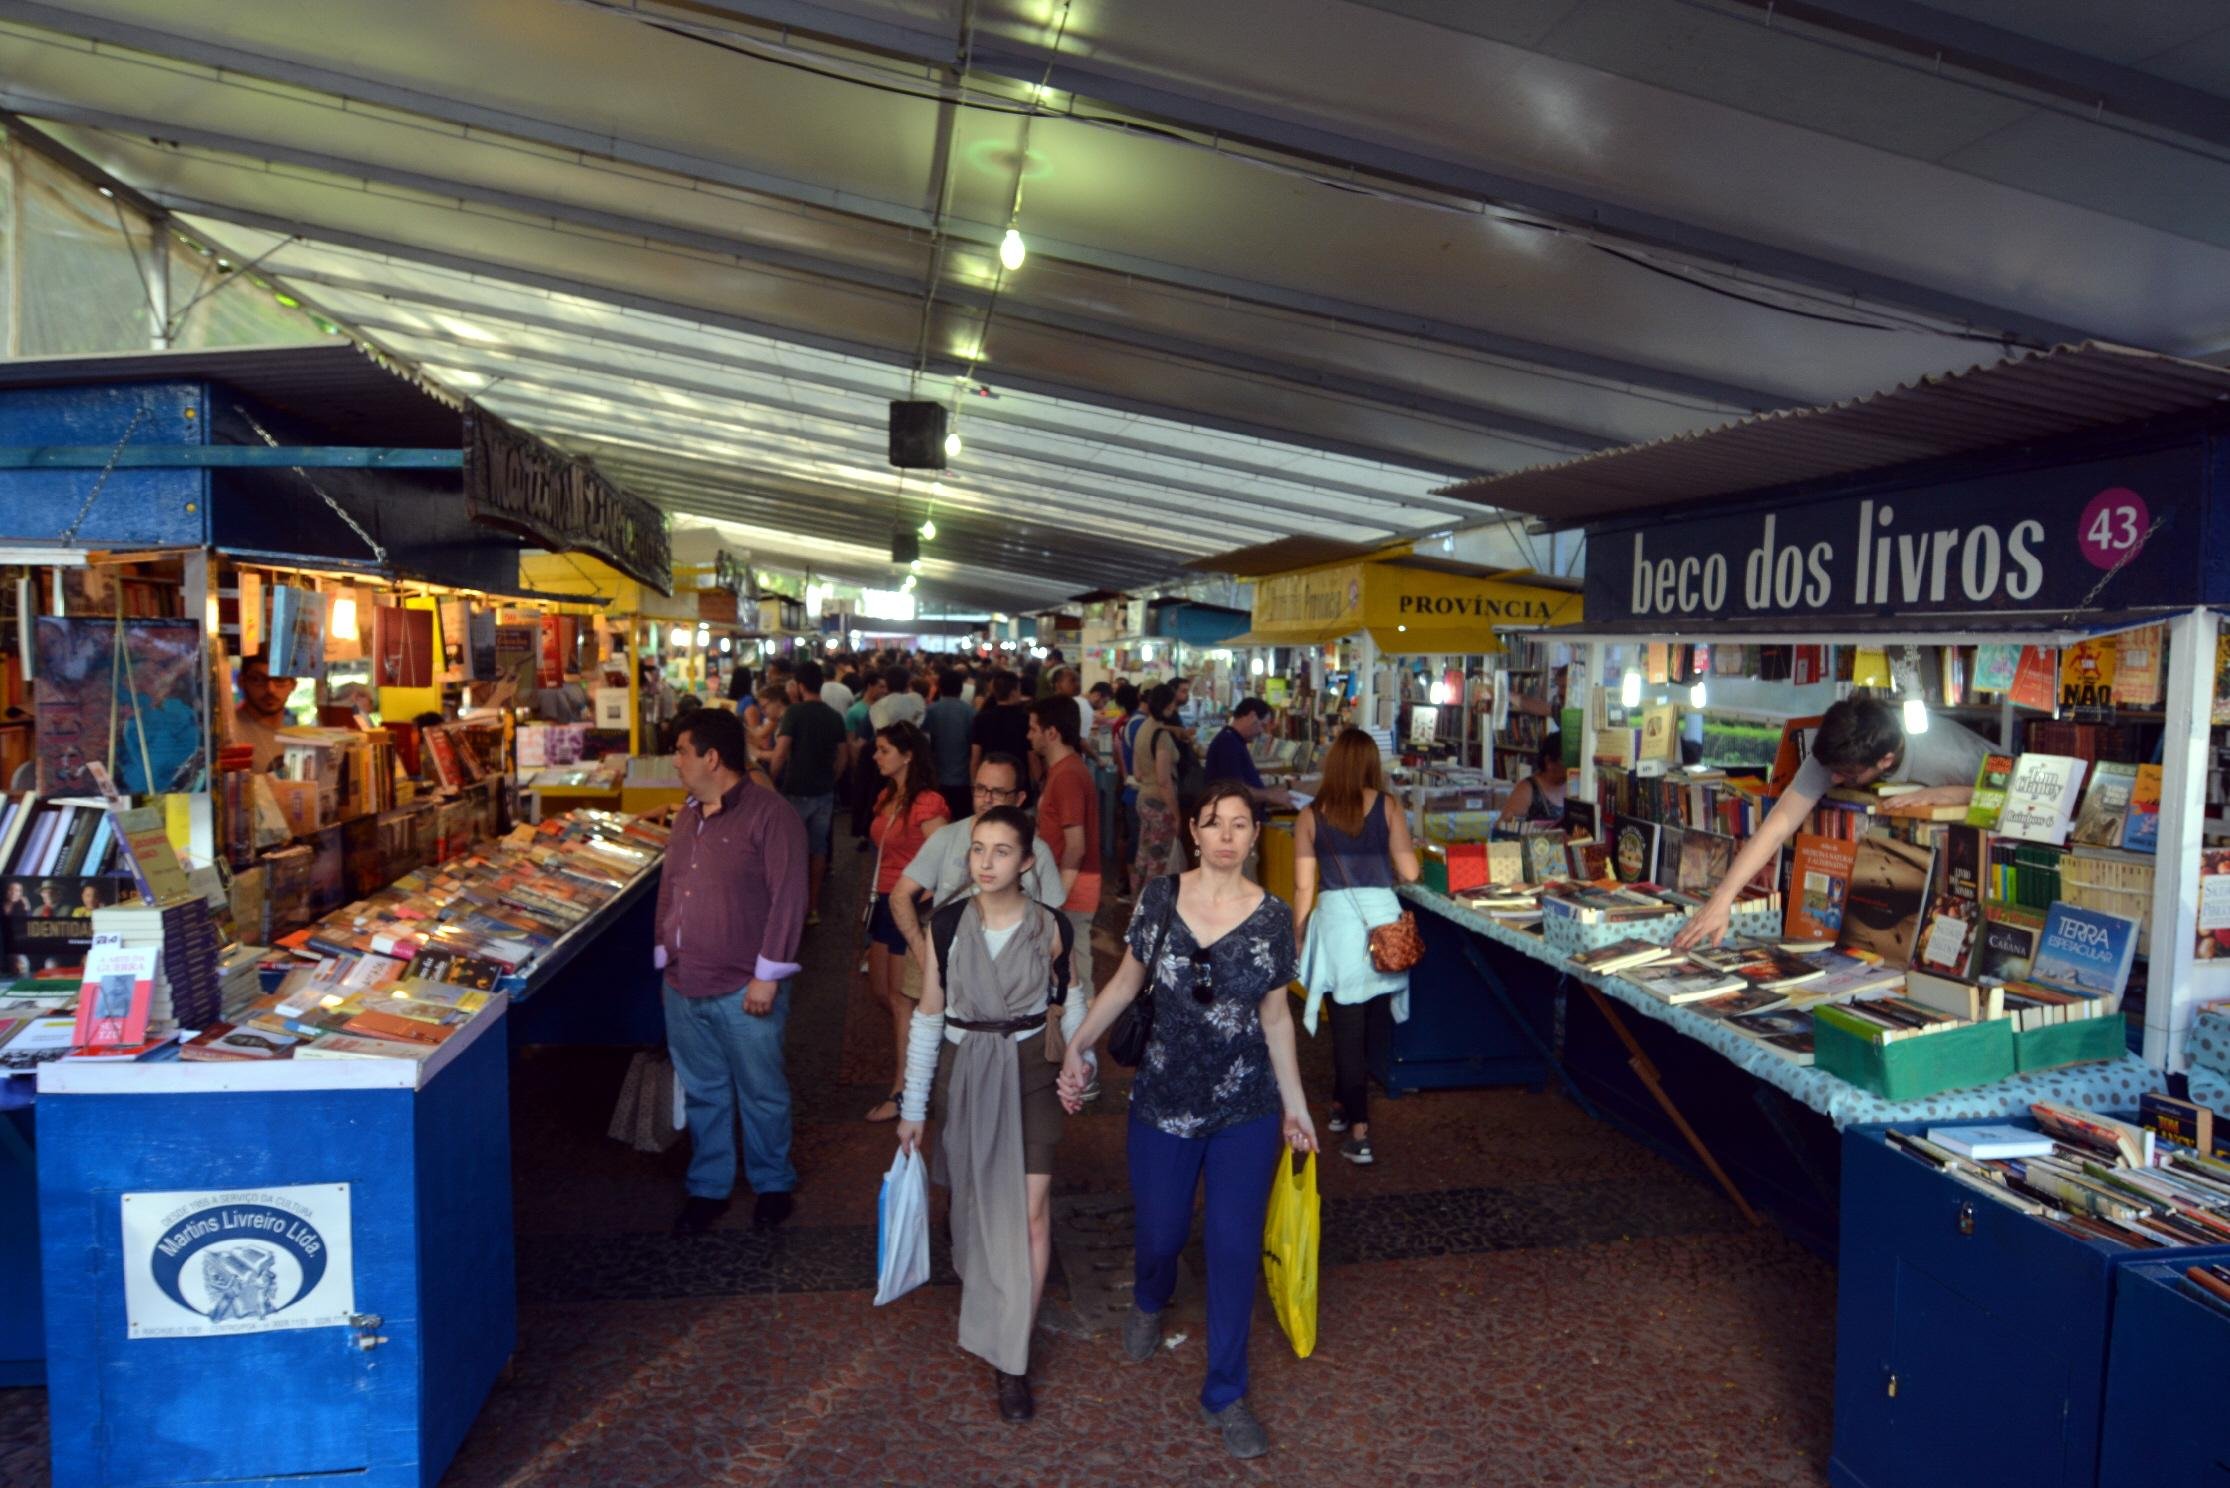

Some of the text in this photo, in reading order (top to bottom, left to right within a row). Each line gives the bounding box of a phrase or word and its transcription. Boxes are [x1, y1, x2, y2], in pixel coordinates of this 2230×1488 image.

[2086, 504, 2139, 551] 43
[1631, 499, 2045, 614] beco dos livros
[1399, 594, 1552, 619] PROVÍNCIA
[2056, 916, 2110, 950] TERRA
[157, 1217, 220, 1258] Martins
[221, 1209, 288, 1234] Livreiro
